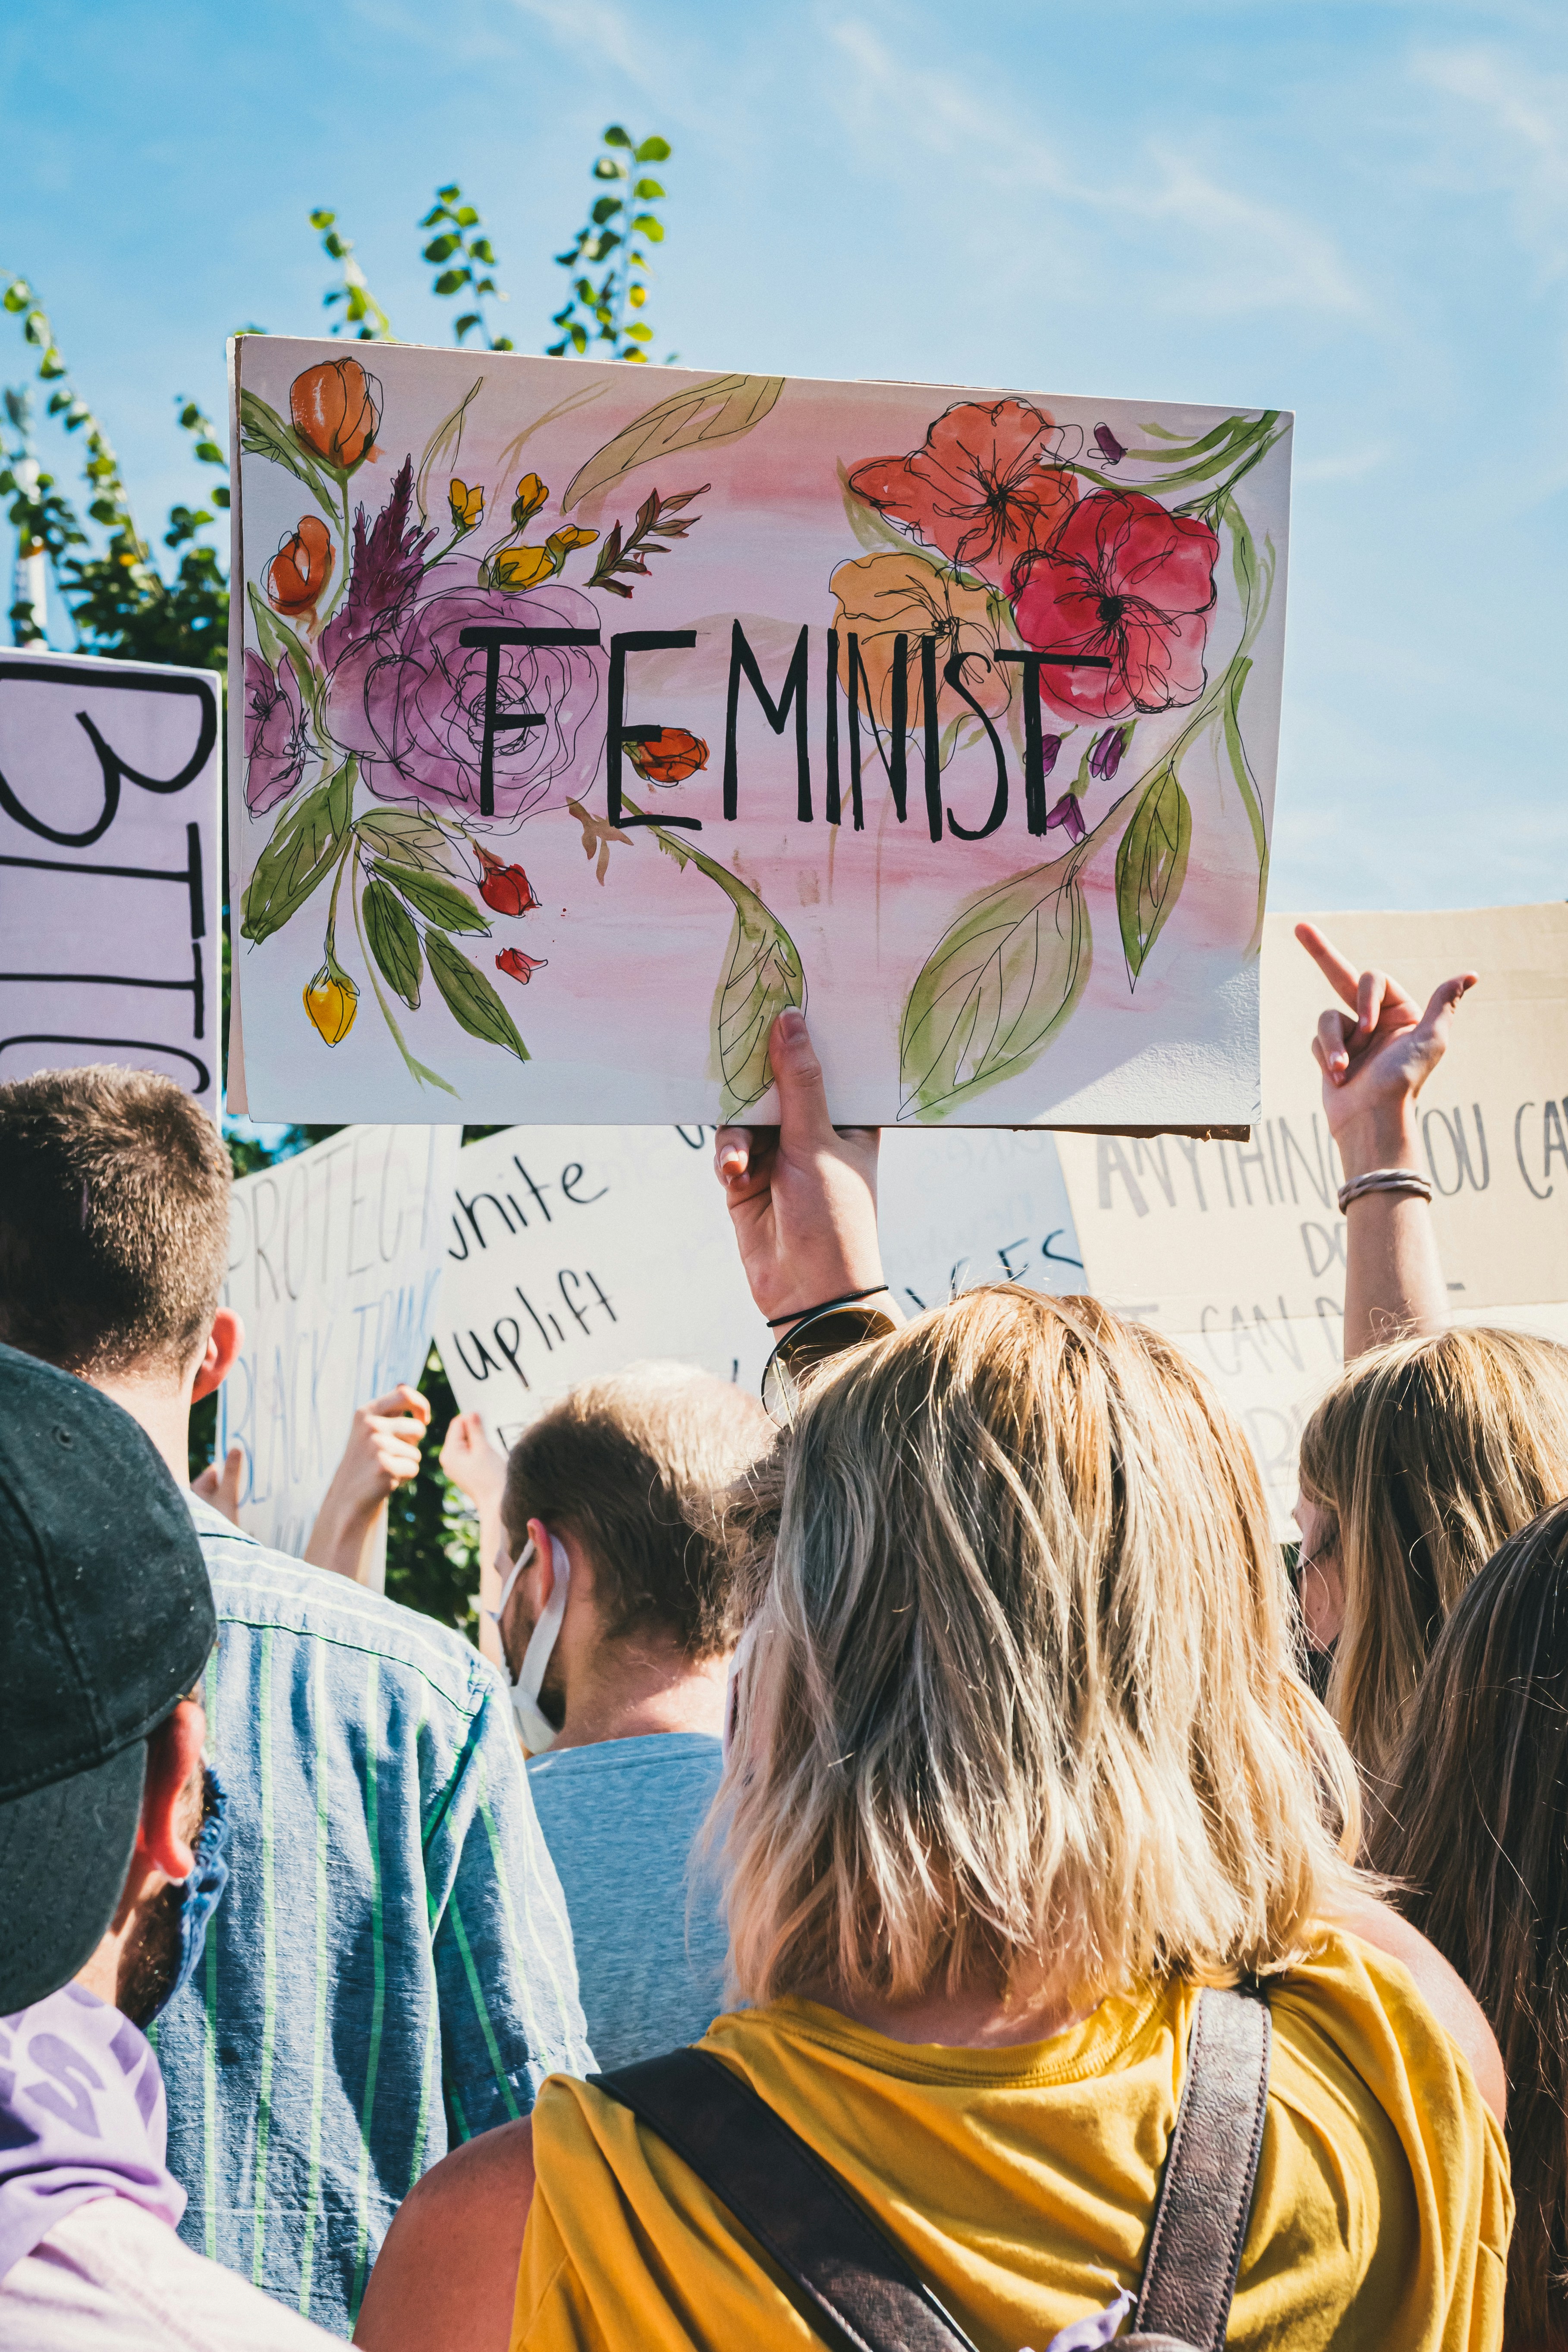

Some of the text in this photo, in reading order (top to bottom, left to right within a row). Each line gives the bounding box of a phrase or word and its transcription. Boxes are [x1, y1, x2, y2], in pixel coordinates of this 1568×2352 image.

[459, 619, 1112, 843] FEMINIST
[1415, 1103, 1490, 1196] OU
[1515, 1096, 1568, 1200] CA
[453, 1270, 617, 1391] uplift
[1201, 1295, 1306, 1376] CAN
